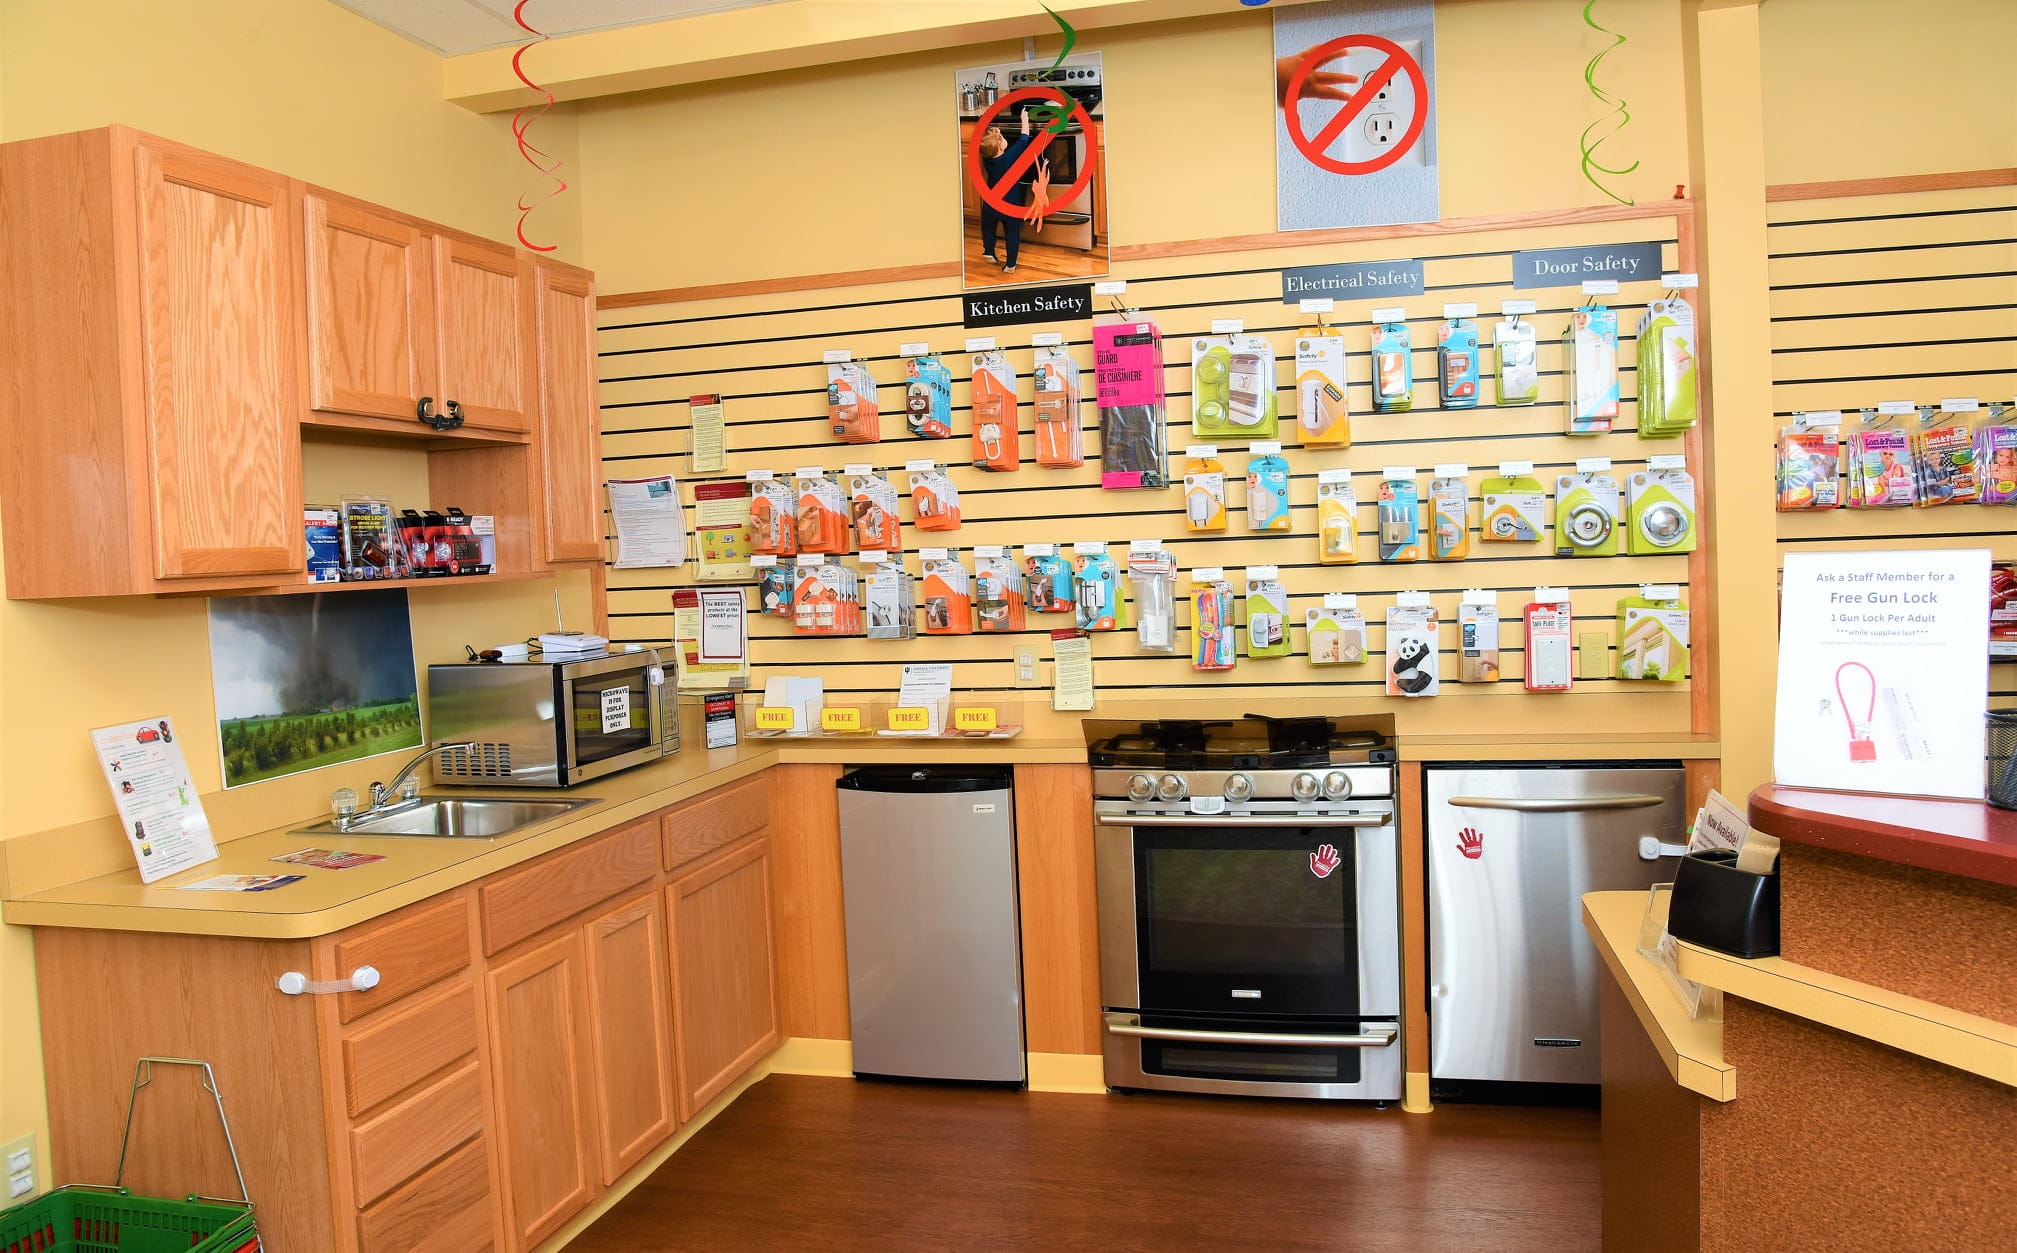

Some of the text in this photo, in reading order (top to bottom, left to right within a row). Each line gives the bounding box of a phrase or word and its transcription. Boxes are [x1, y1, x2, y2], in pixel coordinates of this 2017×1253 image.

[1534, 255, 1641, 275] Door Safety
[1286, 269, 1420, 292] Electrical Safety
[969, 295, 1084, 317] Kitchen Safety
[1097, 354, 1118, 365] GUARD
[1098, 373, 1106, 383] DE
[1816, 573, 1835, 582] Ask
[1847, 572, 1874, 582] Staff
[1876, 572, 1925, 581] Member
[1928, 572, 1945, 581] for
[1830, 592, 1938, 604] Free Gun Lock
[1839, 614, 1859, 622] Gun
[1862, 614, 1884, 622] Lock
[1888, 614, 1904, 622] Per
[1907, 614, 1936, 622] Adult
[602, 687, 628, 697] MICROWAVE
[607, 704, 624, 713] DISPLAY
[605, 712, 627, 721] PURPOSES
[762, 713, 787, 721] FREE
[828, 713, 854, 722] FREE
[895, 713, 921, 722] FREE
[962, 713, 989, 721] FREE
[1707, 814, 1718, 830] Now
[1716, 820, 1739, 847] Available!
